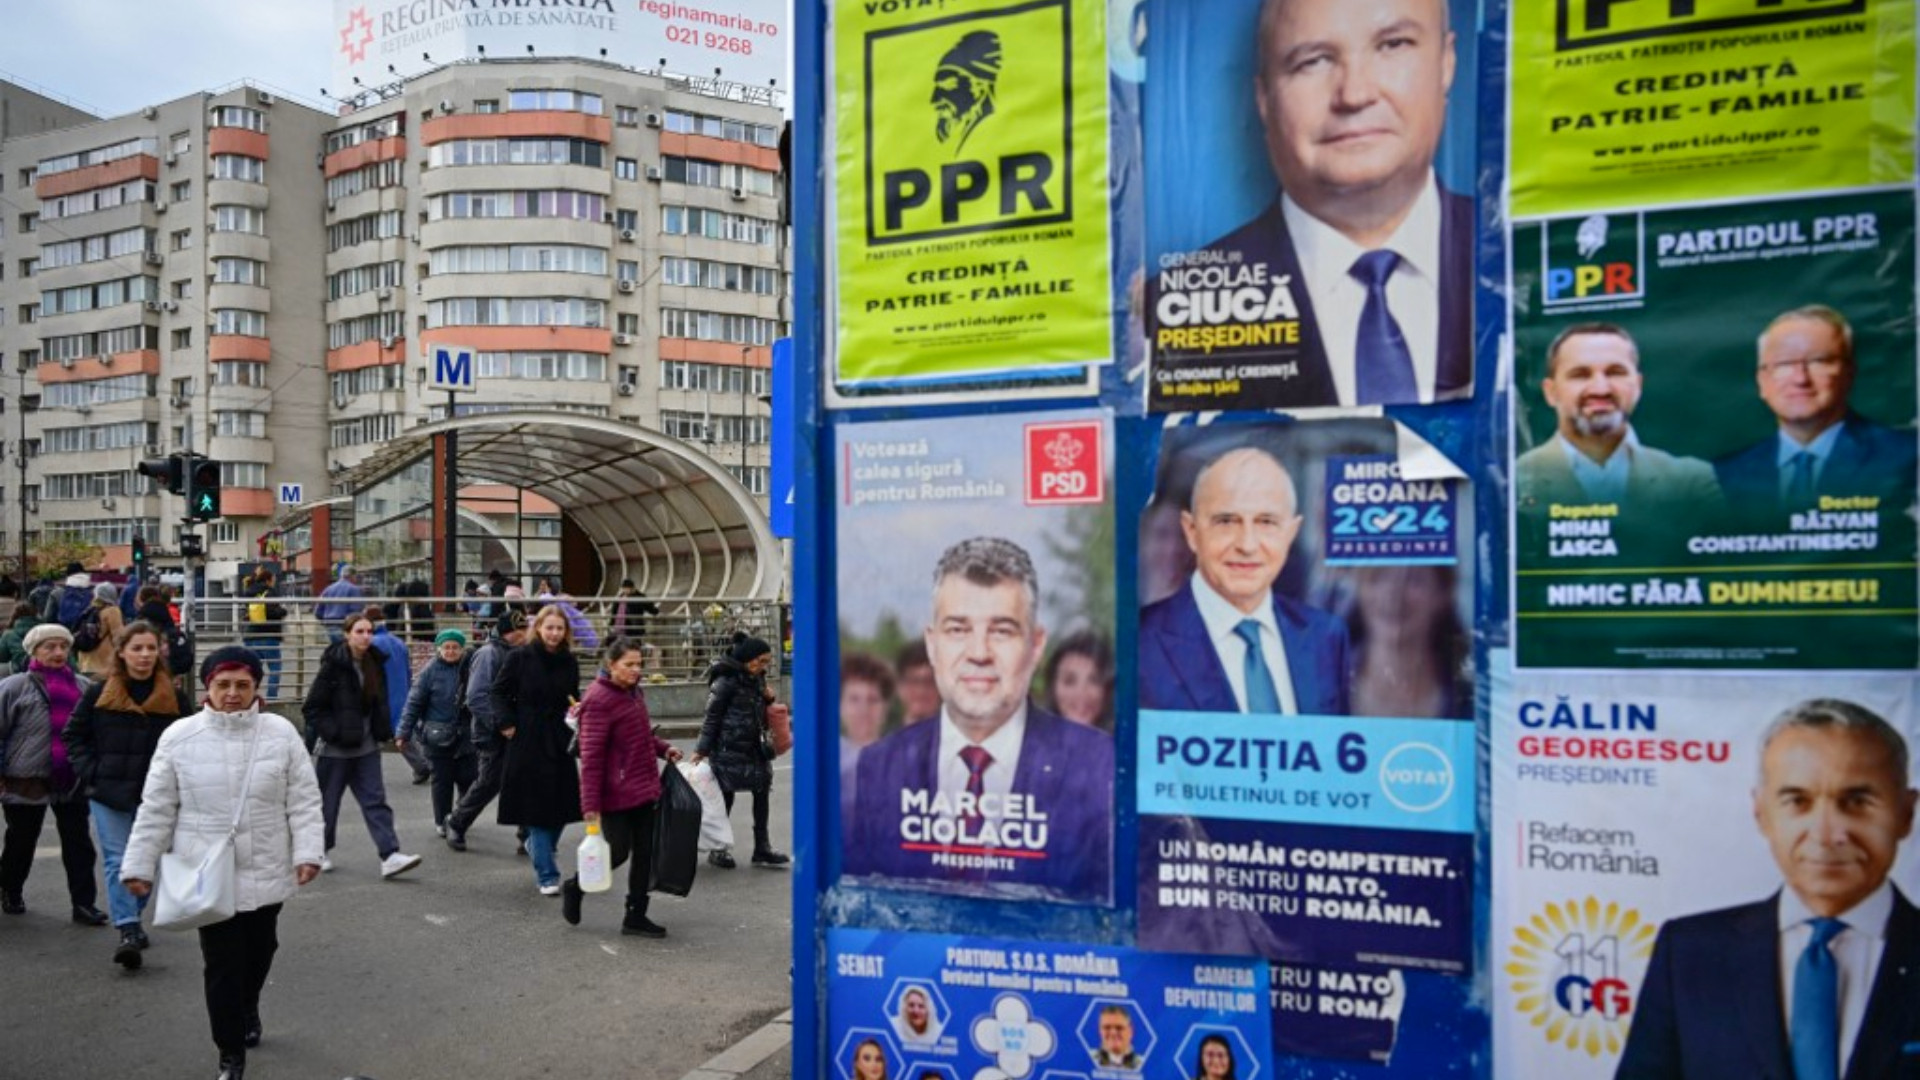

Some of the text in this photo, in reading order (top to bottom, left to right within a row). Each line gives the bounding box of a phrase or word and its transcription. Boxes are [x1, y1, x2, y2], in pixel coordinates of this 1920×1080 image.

[498, 11, 521, 25] DE
[639, 0, 777, 36] reginamaria.ro
[665, 25, 752, 55] 021 9268
[1615, 57, 1799, 97] CREDINȚĂ
[1551, 103, 1682, 133] PATRIE
[1708, 83, 1866, 116] FAMILIE
[884, 151, 1053, 231] PPR
[1657, 213, 1878, 256] PARTIDUL PPR
[906, 255, 1029, 285] CREDINȚĂ
[1160, 263, 1267, 291] NICOLAE
[1549, 262, 1636, 300] PPR
[865, 290, 953, 313] PATRIE
[970, 278, 1075, 302] FAMILIE
[1157, 274, 1299, 326] CIUCĂ
[1158, 321, 1300, 354] PREȘEDINTE
[436, 350, 470, 385] M
[854, 459, 963, 482] calea sigură
[1041, 471, 1087, 496] PSD
[282, 486, 300, 502] M
[854, 480, 1005, 504] pentru România
[1332, 481, 1448, 504] GEOANA
[1332, 505, 1449, 534] 2024
[1549, 520, 1609, 538] MIHAI
[1790, 509, 1878, 530] RĂZVAN
[1549, 538, 1618, 557] LASCA
[1688, 532, 1877, 554] CONSTANTINESCU
[1547, 578, 1879, 606] NIMIC FĂRĂ DUMNEZEU!
[1518, 694, 1657, 731] CĂLIN
[1156, 732, 1368, 783] POZIȚIA 6
[1518, 736, 1730, 763] GEORGESCU
[1386, 768, 1450, 785] VOTAT
[1517, 763, 1658, 787] PREȘEDINTE
[901, 788, 1048, 820] MARCEL
[1155, 782, 1372, 810] PE BULETINUL DE VOT
[900, 815, 1048, 850] CIOLACU
[1529, 820, 1635, 846] Refacem
[1159, 840, 1457, 879] UN ROMÂN COMPETENT.
[1528, 844, 1659, 876] România
[1158, 864, 1388, 898] BUN PENTRU NATO.
[1158, 888, 1442, 928] BUN PENTRU ROMÂNIA.
[837, 953, 884, 978] SENAT
[1194, 965, 1255, 988] CAMERA
